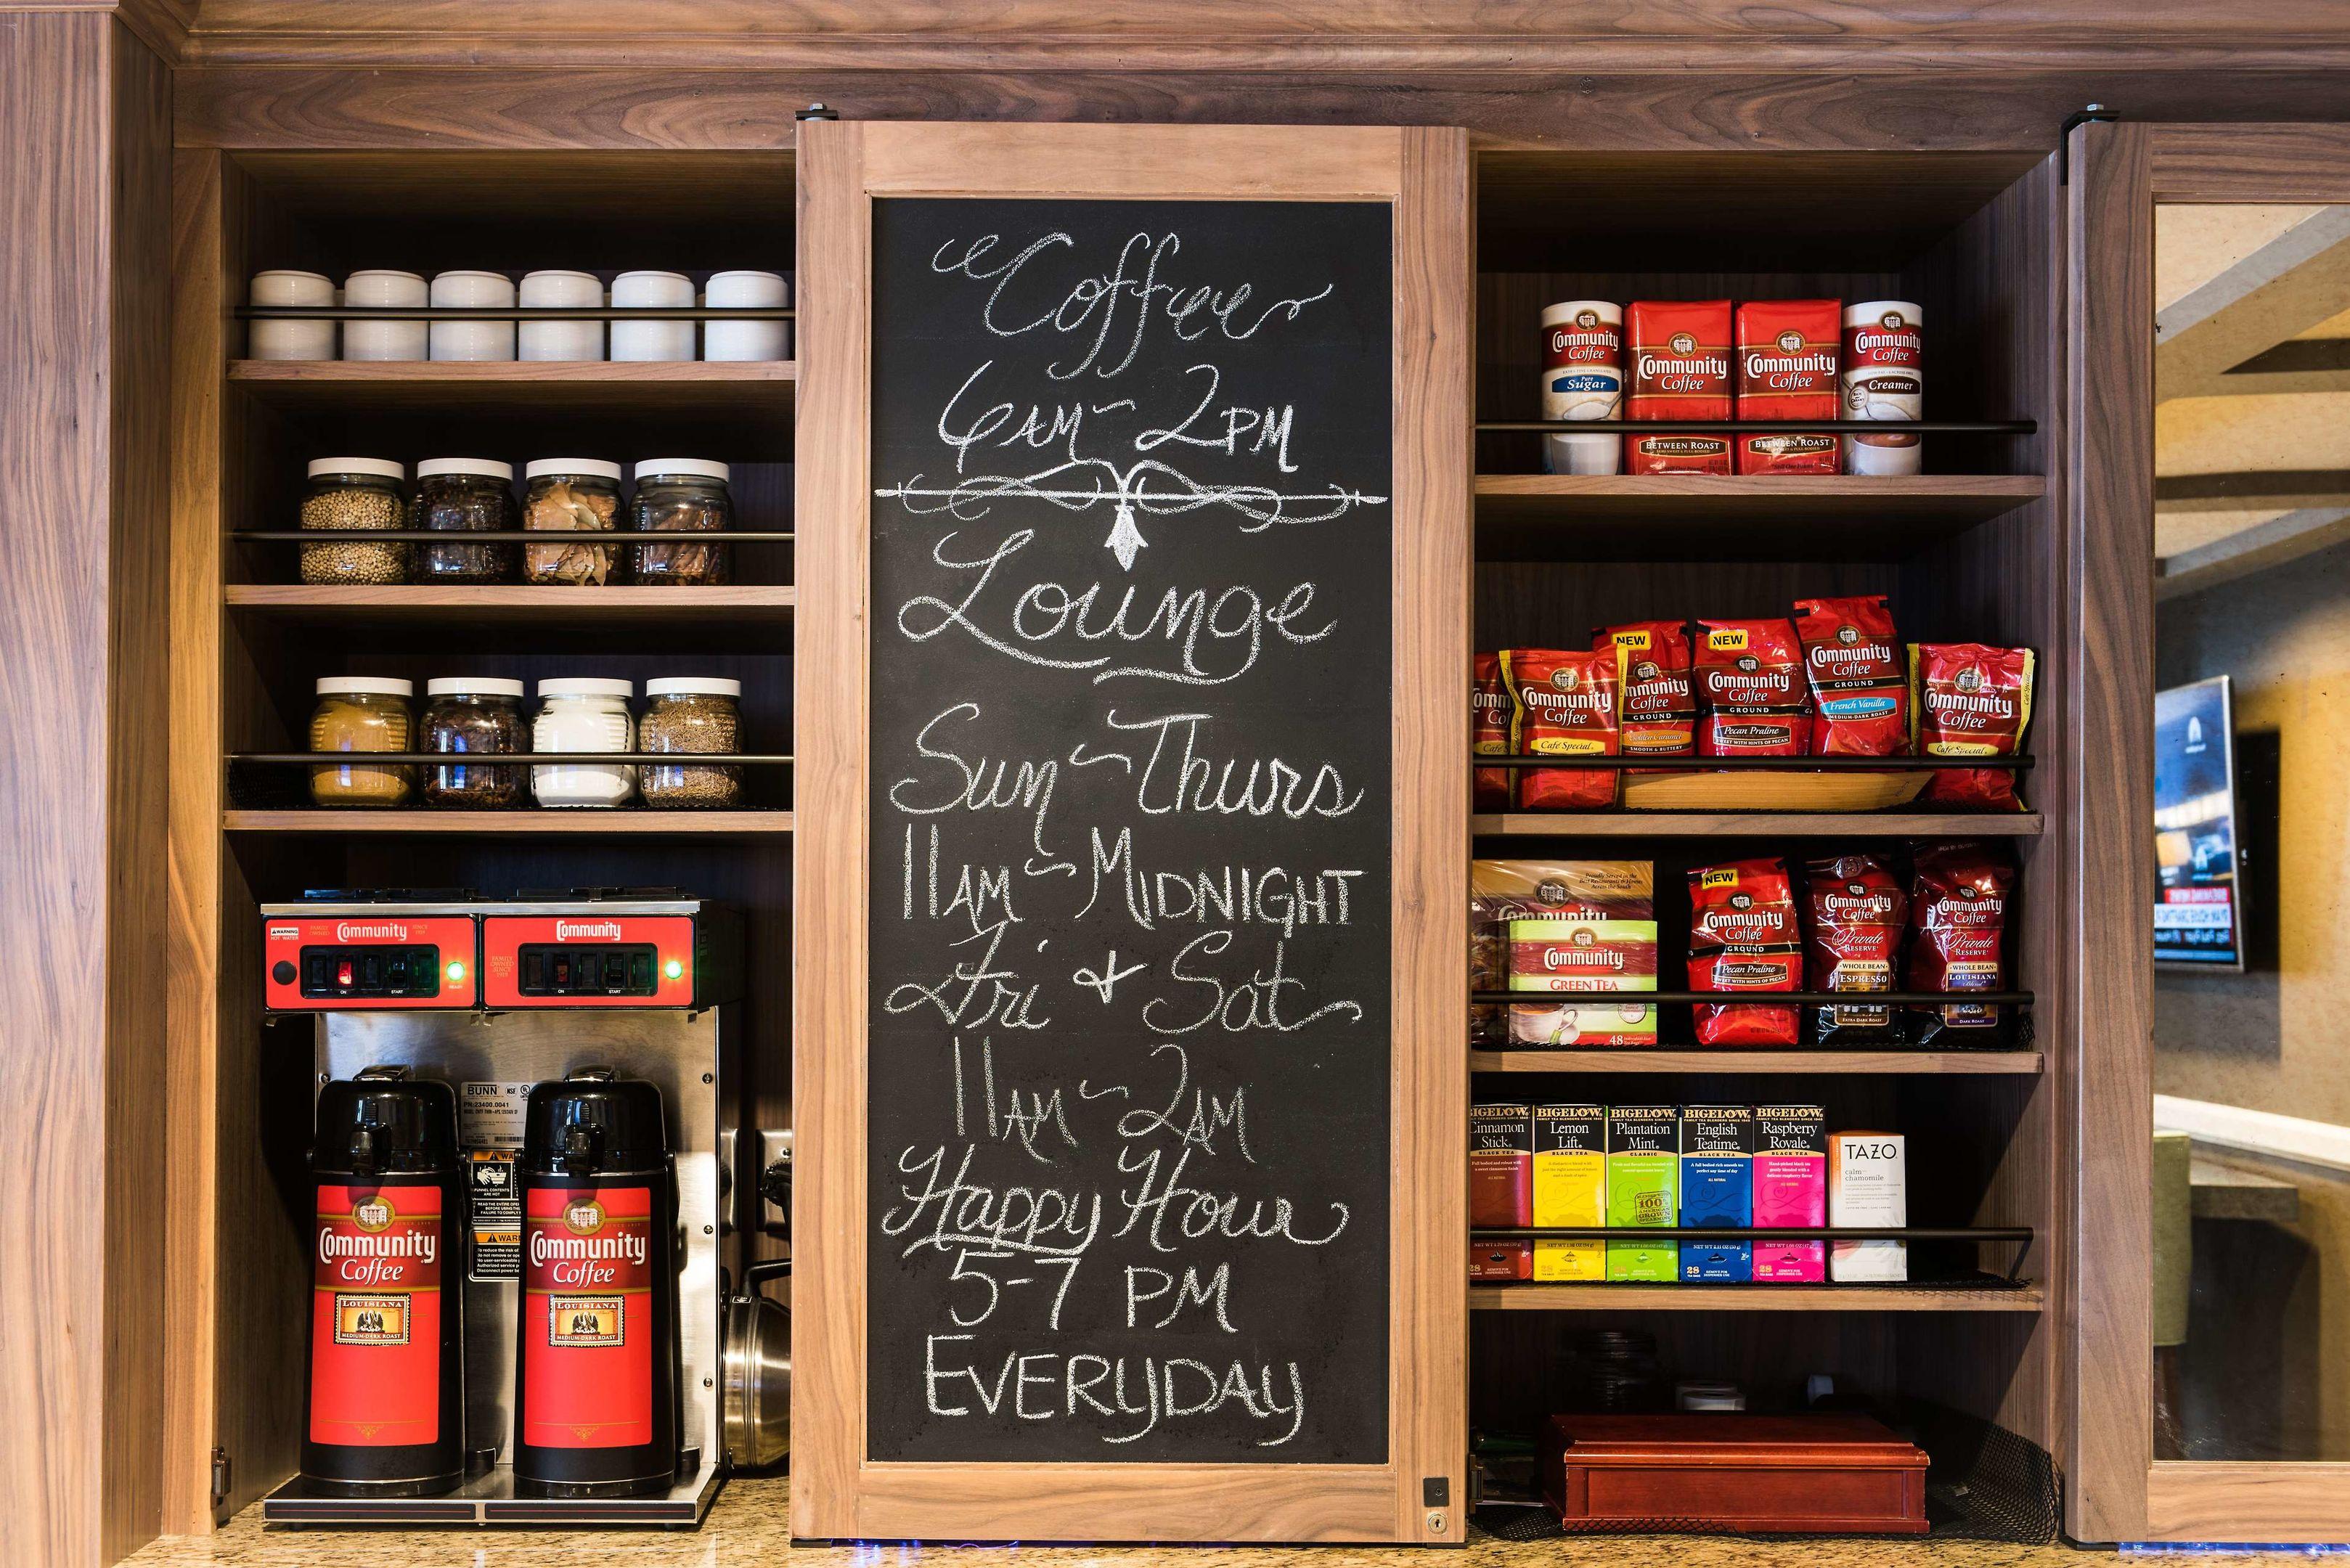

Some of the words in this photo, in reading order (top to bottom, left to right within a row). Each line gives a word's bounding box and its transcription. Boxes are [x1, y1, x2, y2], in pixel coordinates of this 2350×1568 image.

[931, 232, 1334, 380] Coffee
[1552, 330, 1618, 353] Community
[1855, 332, 1920, 354] Community
[1568, 345, 1605, 362] Coffee
[1873, 348, 1909, 363] Coffee
[1639, 355, 1726, 380] Community
[1747, 353, 1835, 379] Community
[1567, 380, 1606, 391] Sugar
[1661, 375, 1705, 393] Coffee
[1769, 372, 1813, 391] Coffee
[1869, 380, 1913, 390] Creamer
[1755, 439, 1797, 448] BETWEEN
[898, 528, 1337, 685] Lounge
[1617, 636, 1646, 645] NEW
[1713, 635, 1742, 645] NEW
[1811, 643, 1891, 668] Community
[1832, 661, 1871, 678] Coffee
[1625, 677, 1689, 697] mmunity
[1708, 671, 1790, 693] Community
[1522, 687, 1612, 713] Community
[1631, 695, 1668, 711] Coffee
[1729, 687, 1768, 703] Coffee
[1924, 687, 2012, 719] Community
[1830, 699, 1856, 710] French
[1858, 698, 1885, 708] Vanilla
[1544, 709, 1588, 726] Coffee
[1940, 710, 1986, 730] Coffee
[1563, 741, 1592, 751] Special
[890, 703, 1058, 856] Sun
[1107, 709, 1364, 817] Thurs
[1075, 827, 1368, 937] MIDNIGHT
[1705, 873, 1734, 886] NEW
[1825, 894, 1891, 912] Community
[1937, 897, 2002, 915] Community
[1703, 910, 1783, 933] Community
[1843, 907, 1875, 921] Coffee
[1954, 911, 1986, 926] Coffee
[337, 923, 407, 942] Community
[556, 920, 621, 942] Community
[1725, 926, 1763, 942] Coffee
[1832, 928, 1884, 945] Private
[1947, 932, 1994, 952] Private
[1543, 947, 1624, 971] Community
[884, 920, 1050, 1029] Fri
[1142, 930, 1362, 1034] Sat
[1550, 979, 1592, 991] GREEN
[1594, 979, 1618, 991] TEA
[1609, 1034, 1623, 1045] 48
[468, 1086, 497, 1095] BUNN
[1118, 1044, 1257, 1163] 2AM
[1536, 1108, 1602, 1117] BIGELOW
[1610, 1108, 1676, 1118] BIGELOW
[1684, 1109, 1750, 1119] BIGELOW
[1756, 1108, 1823, 1117] BIGELOW
[1471, 1122, 1525, 1133] Cinnamon
[1550, 1122, 1589, 1133] Lemon
[1616, 1122, 1670, 1135] Plantation
[1697, 1122, 1737, 1138] English
[1762, 1122, 1817, 1137] Raspberry
[1482, 1135, 1509, 1148] Stick
[1558, 1136, 1578, 1148] Lift
[1628, 1137, 1655, 1149] Mint
[1694, 1138, 1737, 1150] Teatime
[1770, 1136, 1807, 1150] Royale
[1845, 1144, 1896, 1159] TAZO
[882, 1143, 1101, 1258] Happy
[1113, 1146, 1350, 1252] Hour
[319, 1227, 436, 1264] Community
[531, 1230, 646, 1267] Community
[340, 1258, 404, 1286] Coffee
[553, 1260, 615, 1288] Coffee
[949, 1249, 1081, 1330] 5-7
[1125, 1262, 1239, 1334] PM
